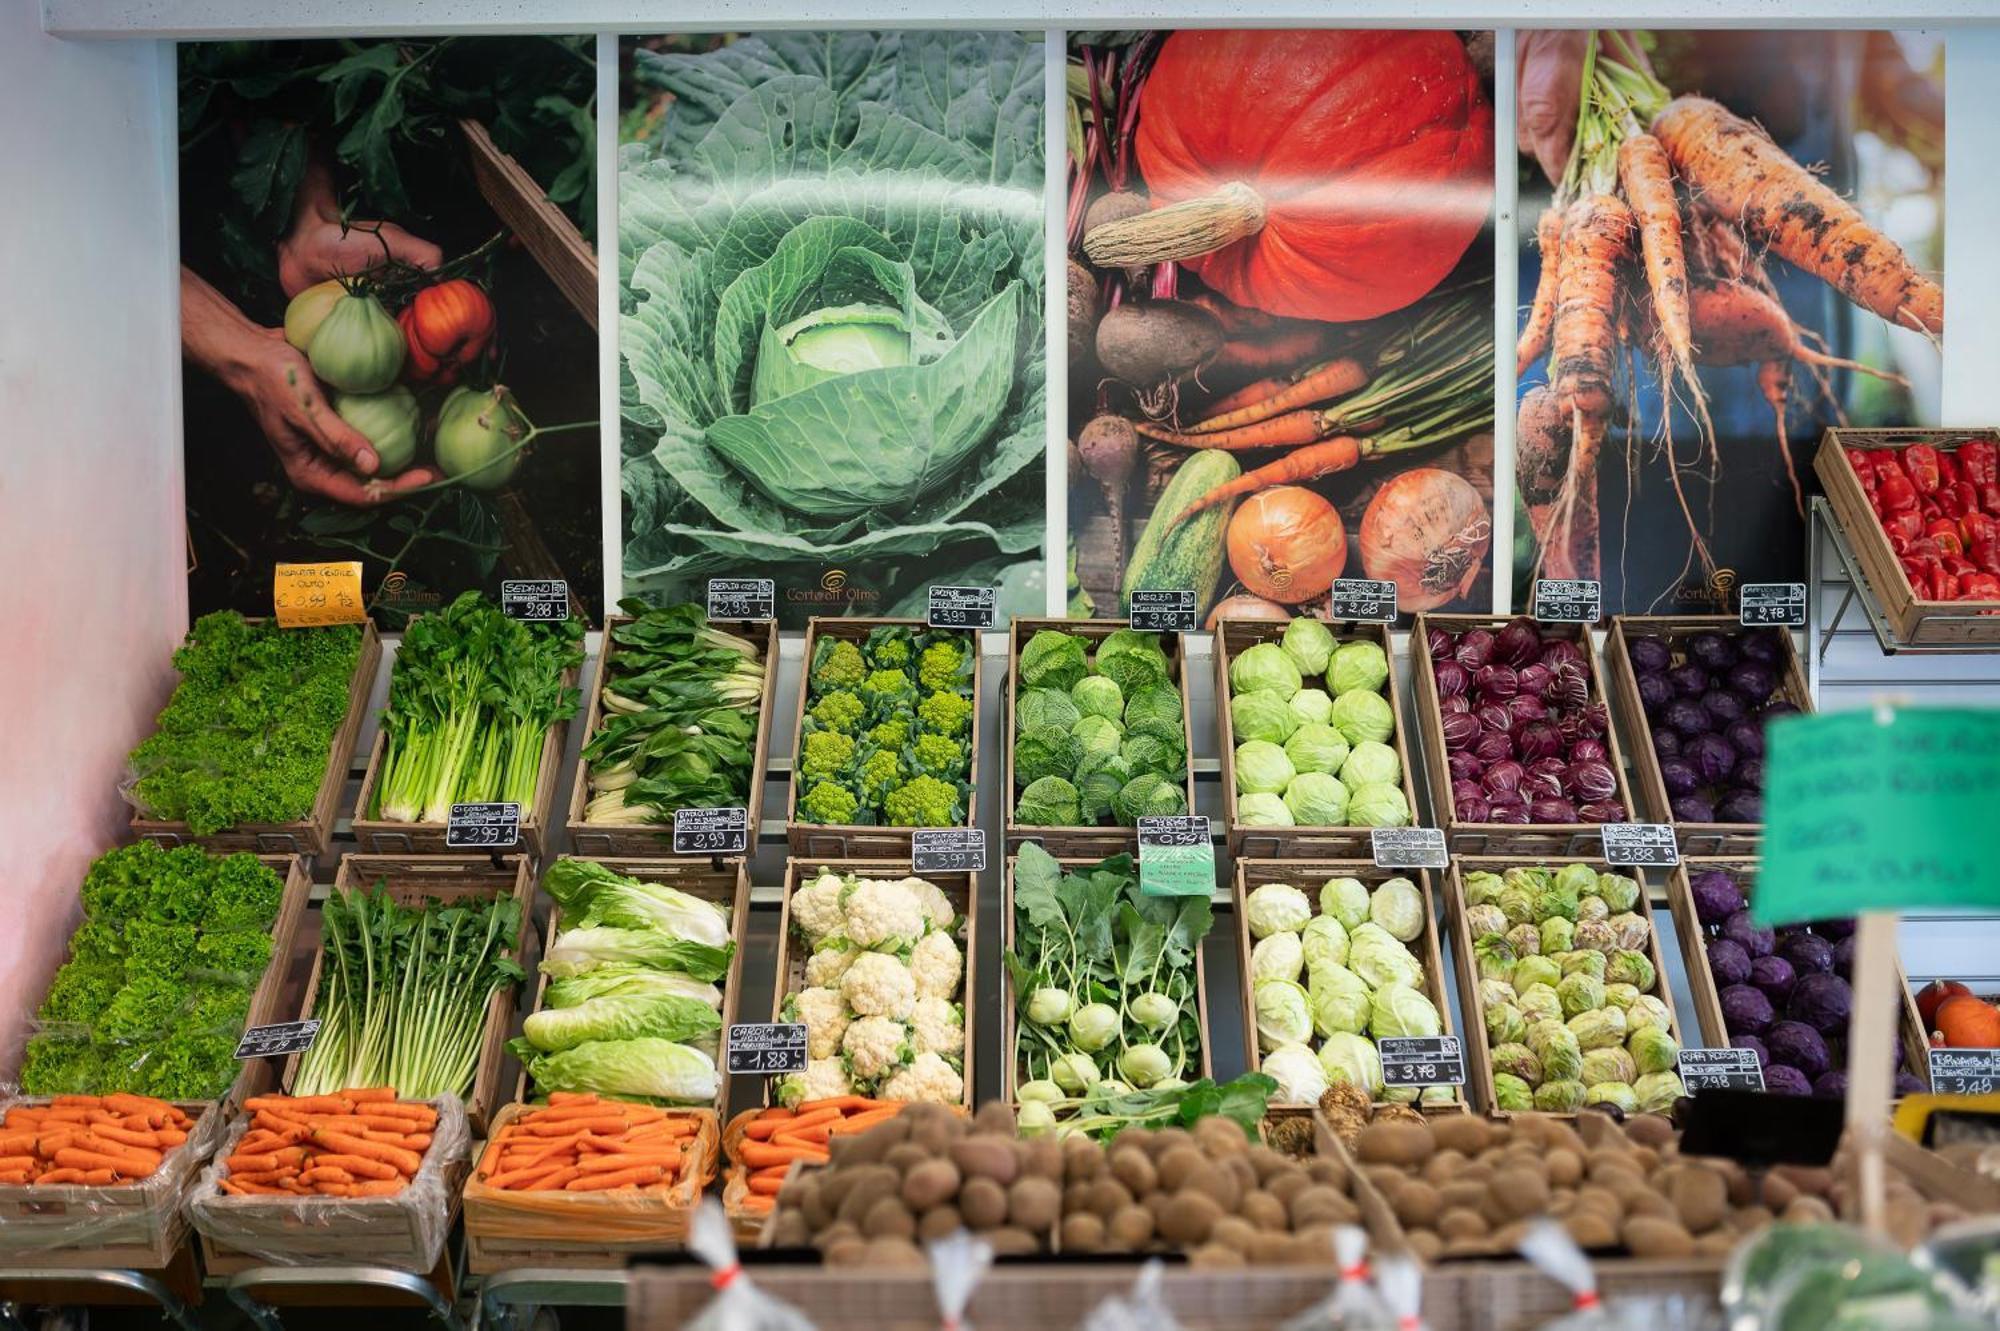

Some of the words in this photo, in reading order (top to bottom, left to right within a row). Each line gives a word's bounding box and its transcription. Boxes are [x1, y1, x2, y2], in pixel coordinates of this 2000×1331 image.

[504, 583, 551, 593] SEDANO
[524, 602, 552, 618] 2,88
[1348, 602, 1379, 616] 2,68
[1547, 602, 1580, 619] 3,99
[465, 826, 500, 844] 2,99
[693, 832, 726, 848] 2,99
[936, 853, 966, 868] 3,99
[1620, 847, 1655, 862] 3,88
[732, 1026, 775, 1037] CAROTA
[748, 1050, 788, 1072] 1,88
[1954, 1077, 1993, 1097] 3,48
